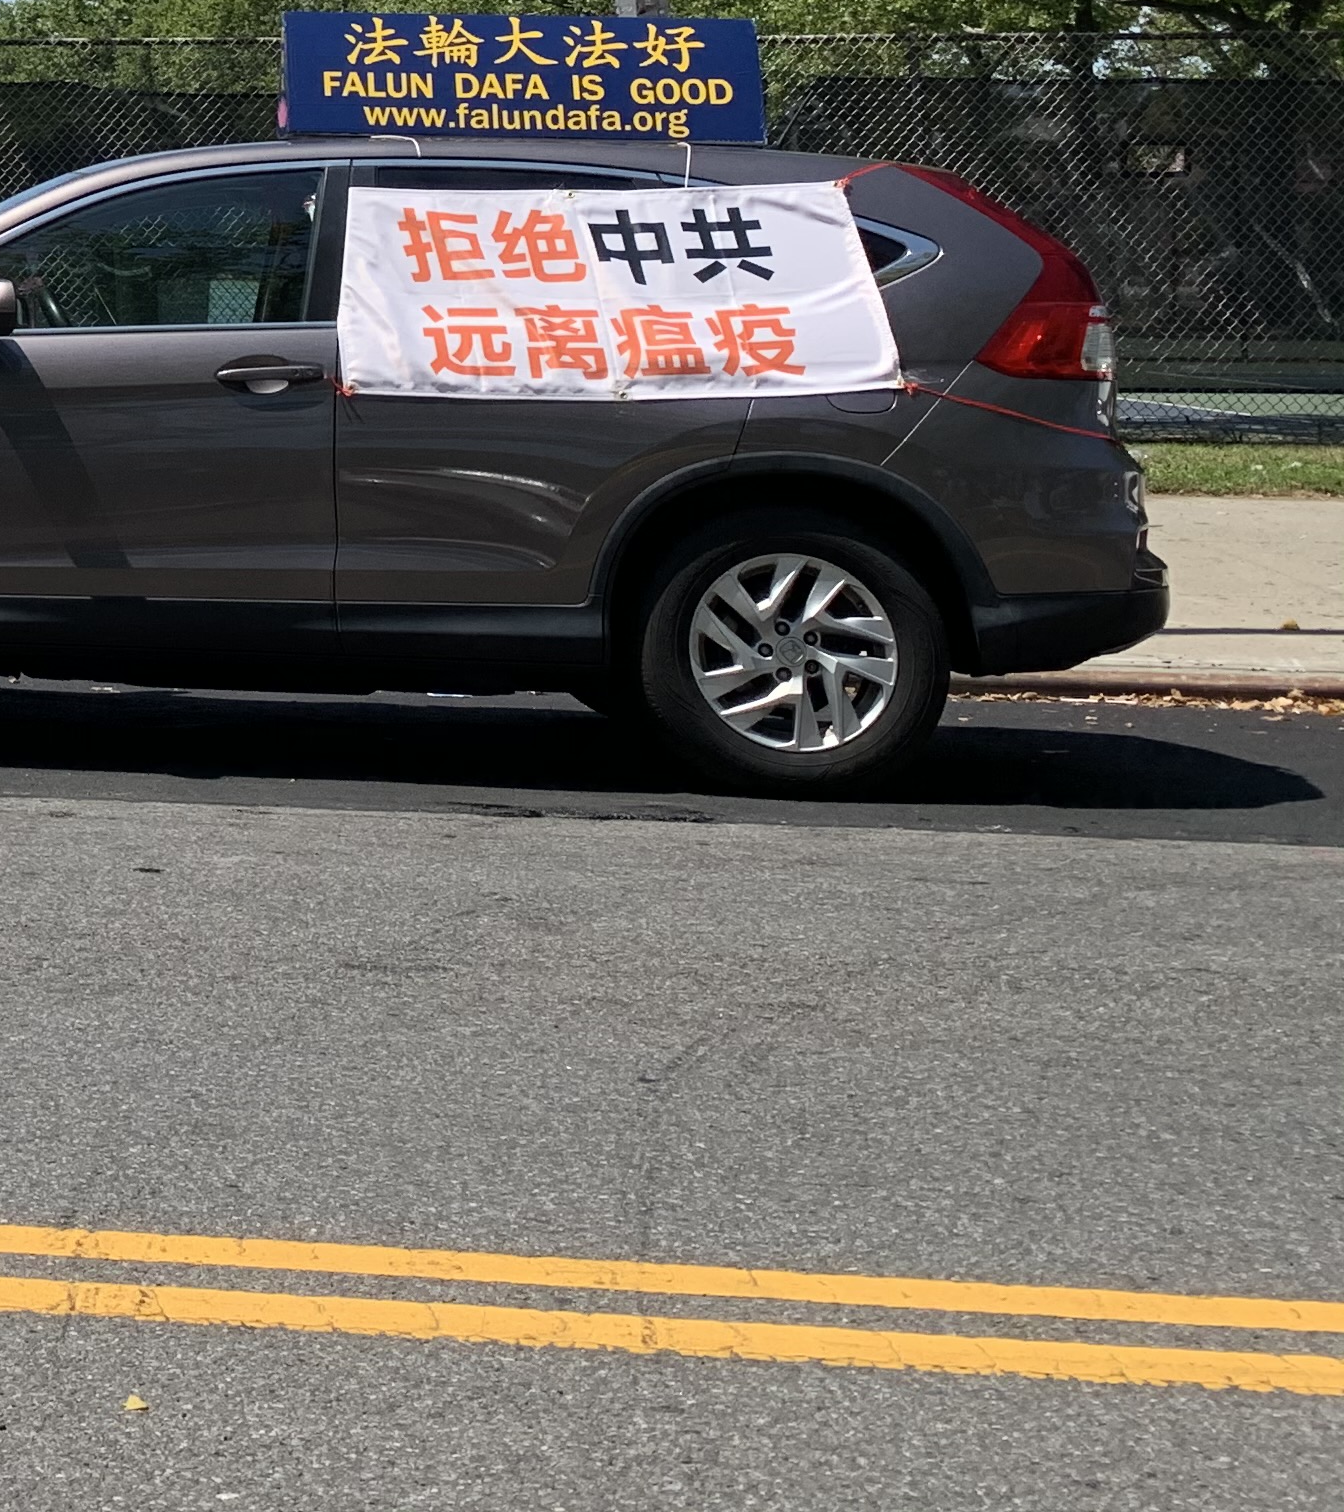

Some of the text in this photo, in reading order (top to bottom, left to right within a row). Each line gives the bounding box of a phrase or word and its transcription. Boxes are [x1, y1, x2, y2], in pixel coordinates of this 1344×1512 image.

[344, 15, 706, 73] 法輪大法好
[323, 71, 734, 105] FALUN DAFA IS GOOD
[363, 102, 691, 138] www.falundafa.org
[398, 206, 775, 285] 拒绝中共
[421, 303, 807, 380] 远离瘟疫
